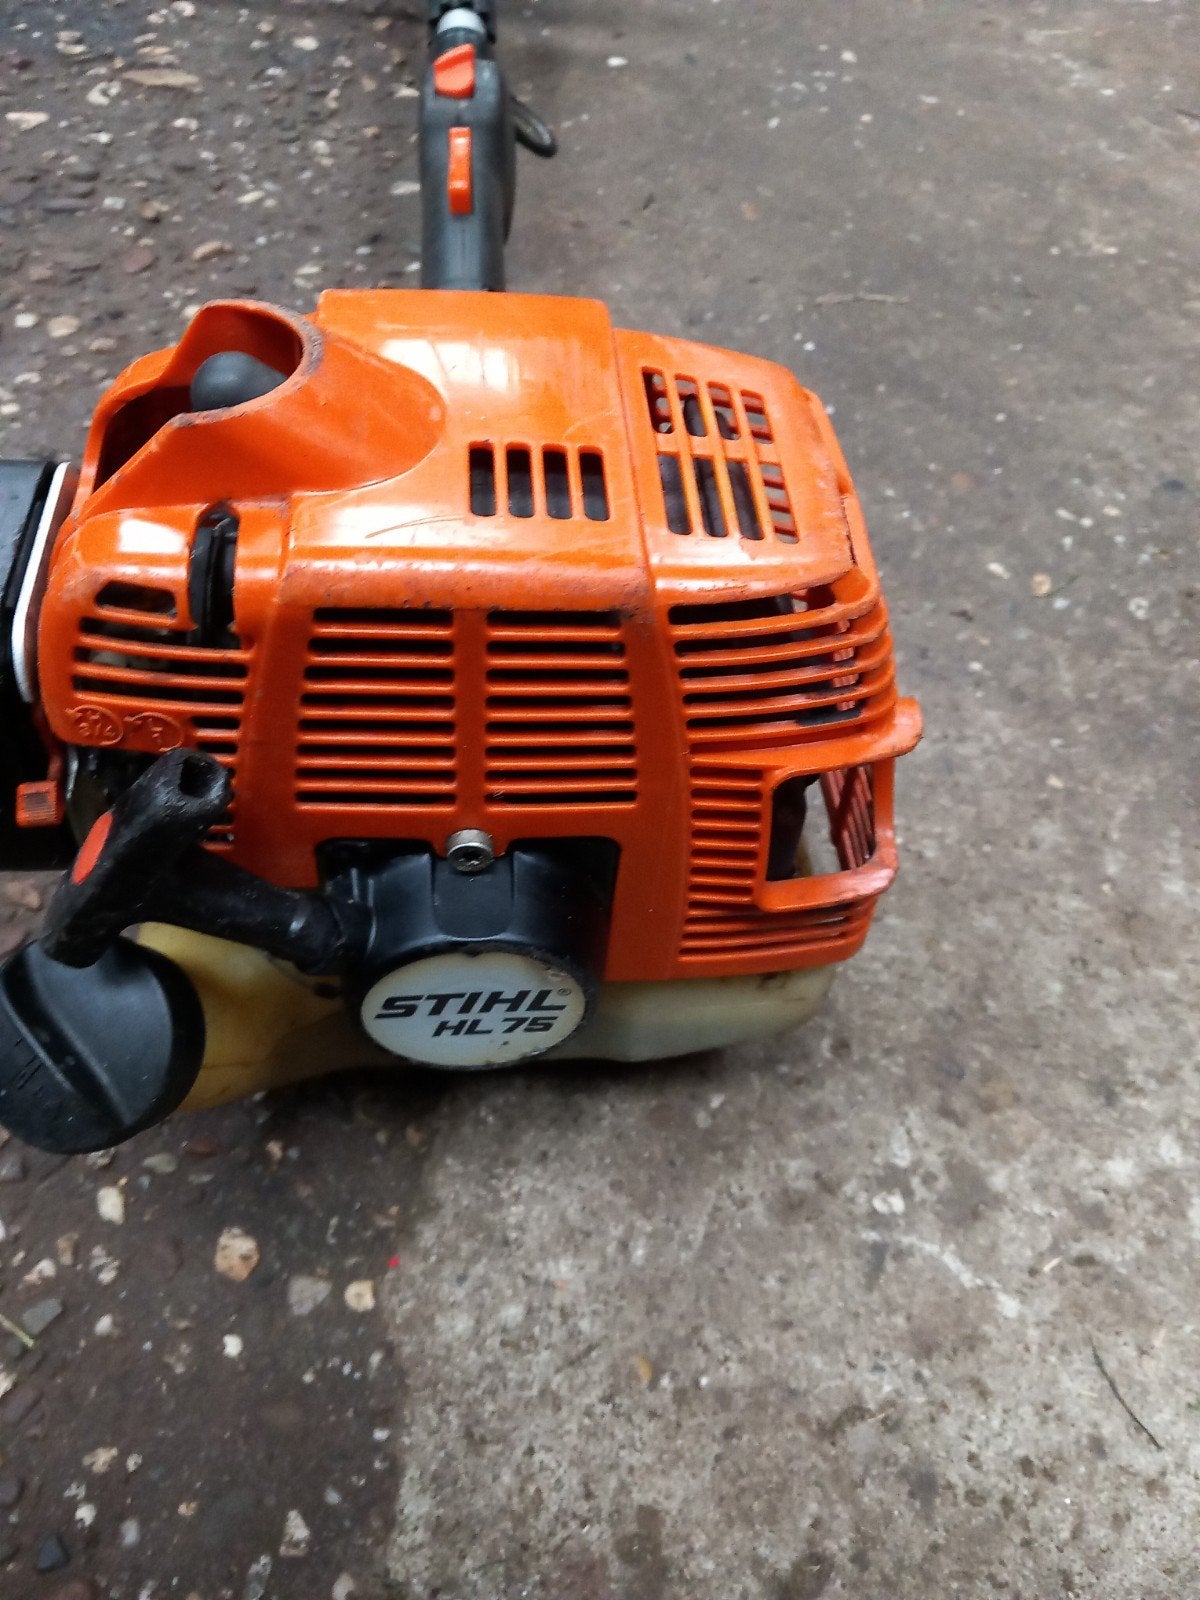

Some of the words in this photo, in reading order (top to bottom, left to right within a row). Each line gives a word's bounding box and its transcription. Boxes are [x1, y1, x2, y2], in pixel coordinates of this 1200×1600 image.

[374, 989, 567, 1019] STIHL
[432, 1018, 493, 1038] HL
[502, 1016, 559, 1033] 75
